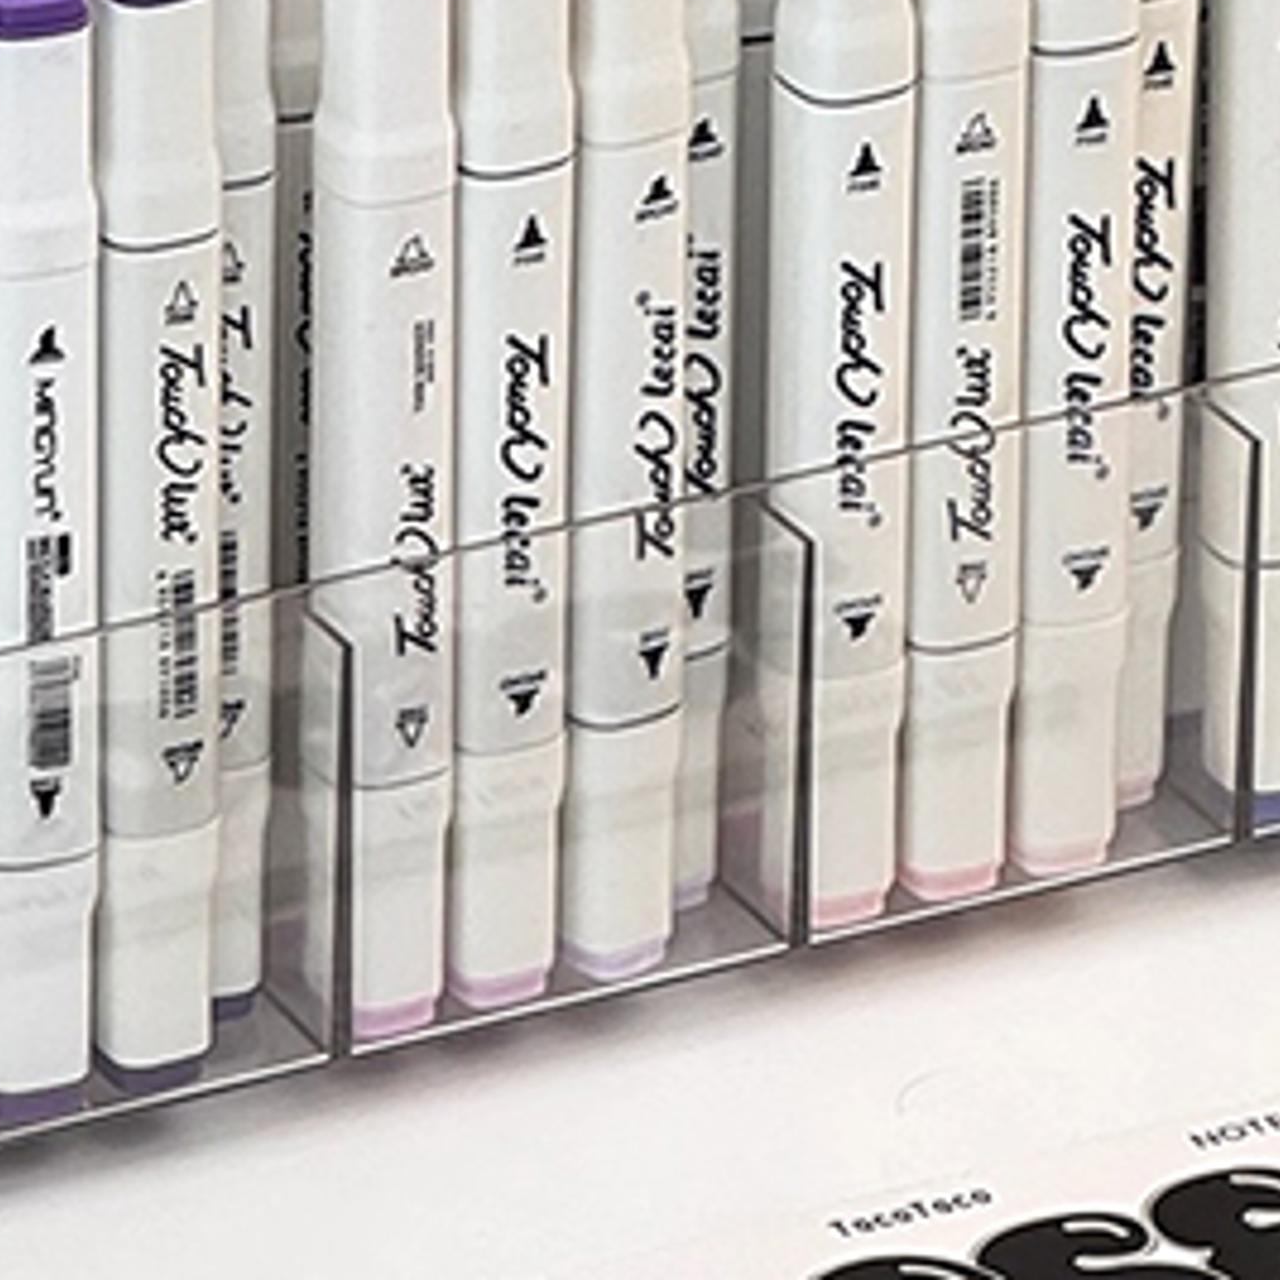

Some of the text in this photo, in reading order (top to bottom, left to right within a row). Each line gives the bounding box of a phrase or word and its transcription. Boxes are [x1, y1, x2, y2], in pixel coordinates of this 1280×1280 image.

[1131, 154, 1177, 304] Touch
[159, 341, 204, 480] Touch
[634, 303, 679, 562] lecai Touch
[834, 260, 885, 514] Touch lecai
[1061, 213, 1113, 470] Touch lecai
[500, 332, 551, 592] Touch lecai
[946, 412, 996, 544] Touch
[390, 526, 438, 658] Touch
